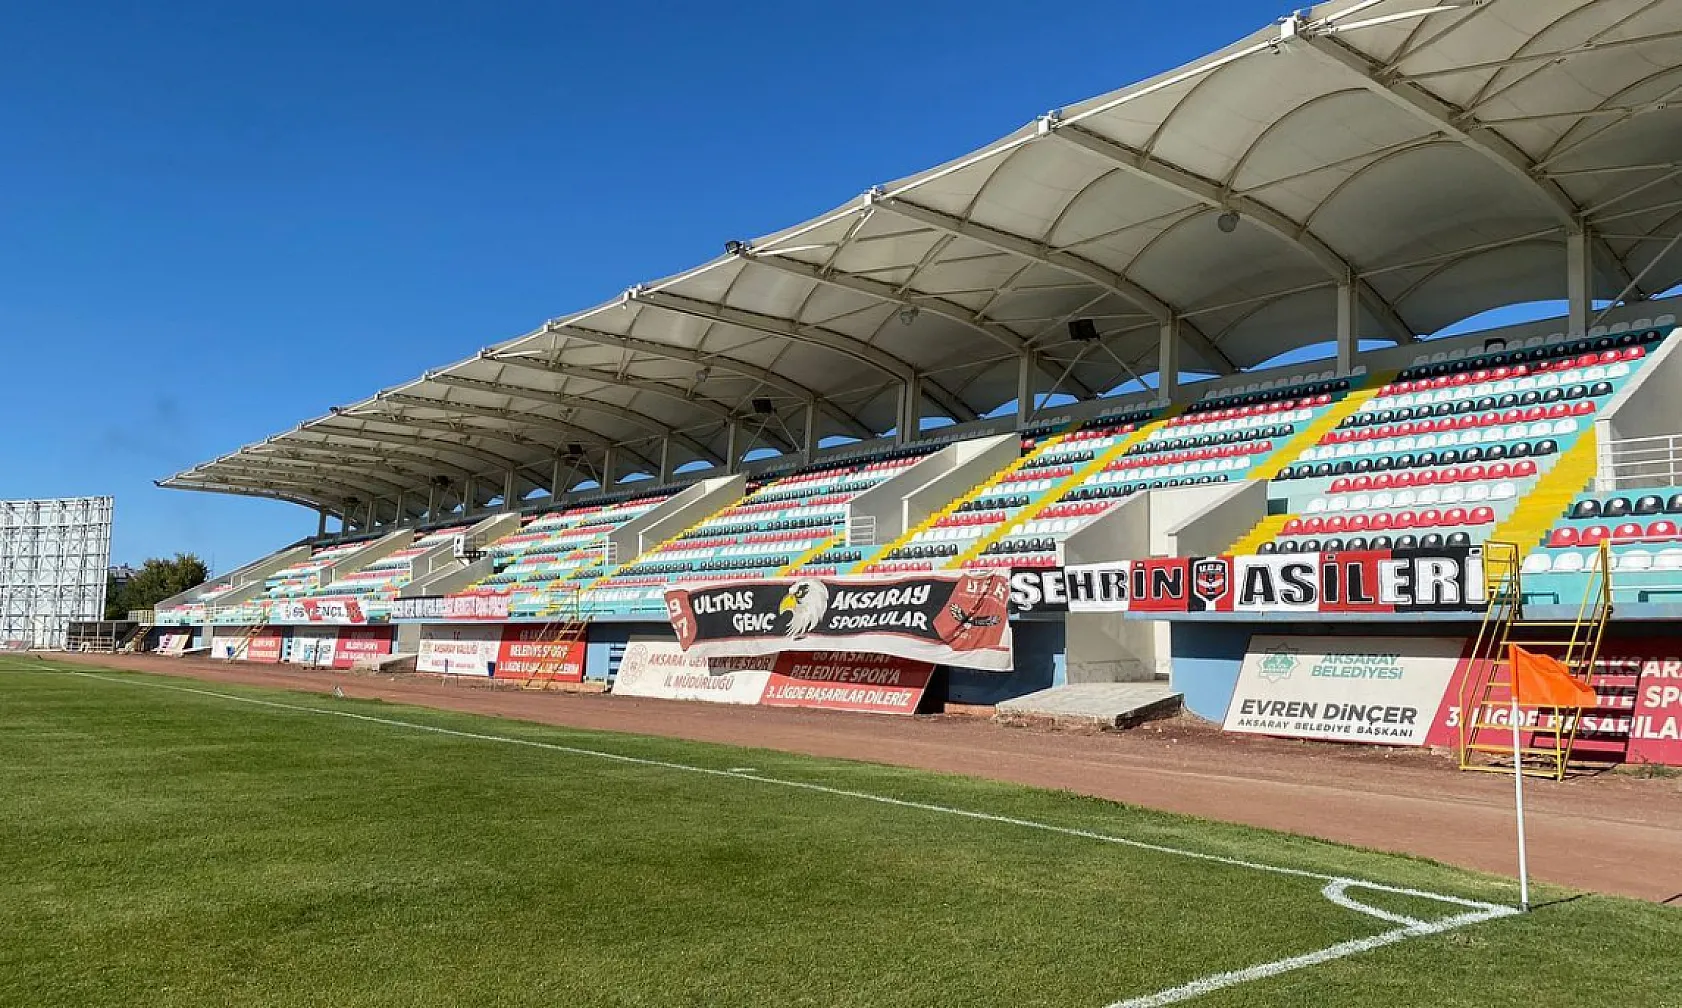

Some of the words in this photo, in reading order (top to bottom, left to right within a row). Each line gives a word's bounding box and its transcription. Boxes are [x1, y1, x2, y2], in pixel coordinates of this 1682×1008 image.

[1010, 562, 1184, 611] ŞEHRİN
[1239, 547, 1488, 606] ASİLERİ
[694, 591, 755, 615] ULTRAS
[830, 584, 931, 611] AKSARAY
[732, 612, 777, 634] GENÇ
[828, 611, 929, 632] SPORLULAR
[1320, 653, 1401, 666] AKSARAY
[1592, 656, 1682, 678] AKSAR
[790, 663, 851, 681] BELEDİYE
[850, 667, 900, 684] SPOR'A
[1311, 666, 1404, 680] BELEDİYESİ
[776, 683, 808, 700] LİGDE
[806, 687, 864, 704] BAŞARILAR
[864, 688, 912, 706] DİLERİZ
[1240, 698, 1318, 719] EVREN
[1322, 703, 1418, 727] DİNÇER
[1237, 718, 1290, 730] AKSARAY
[1294, 722, 1351, 734] BELEDİYE
[1356, 726, 1414, 738] BAŞKANI
[1546, 712, 1682, 741] BAŞARILA
